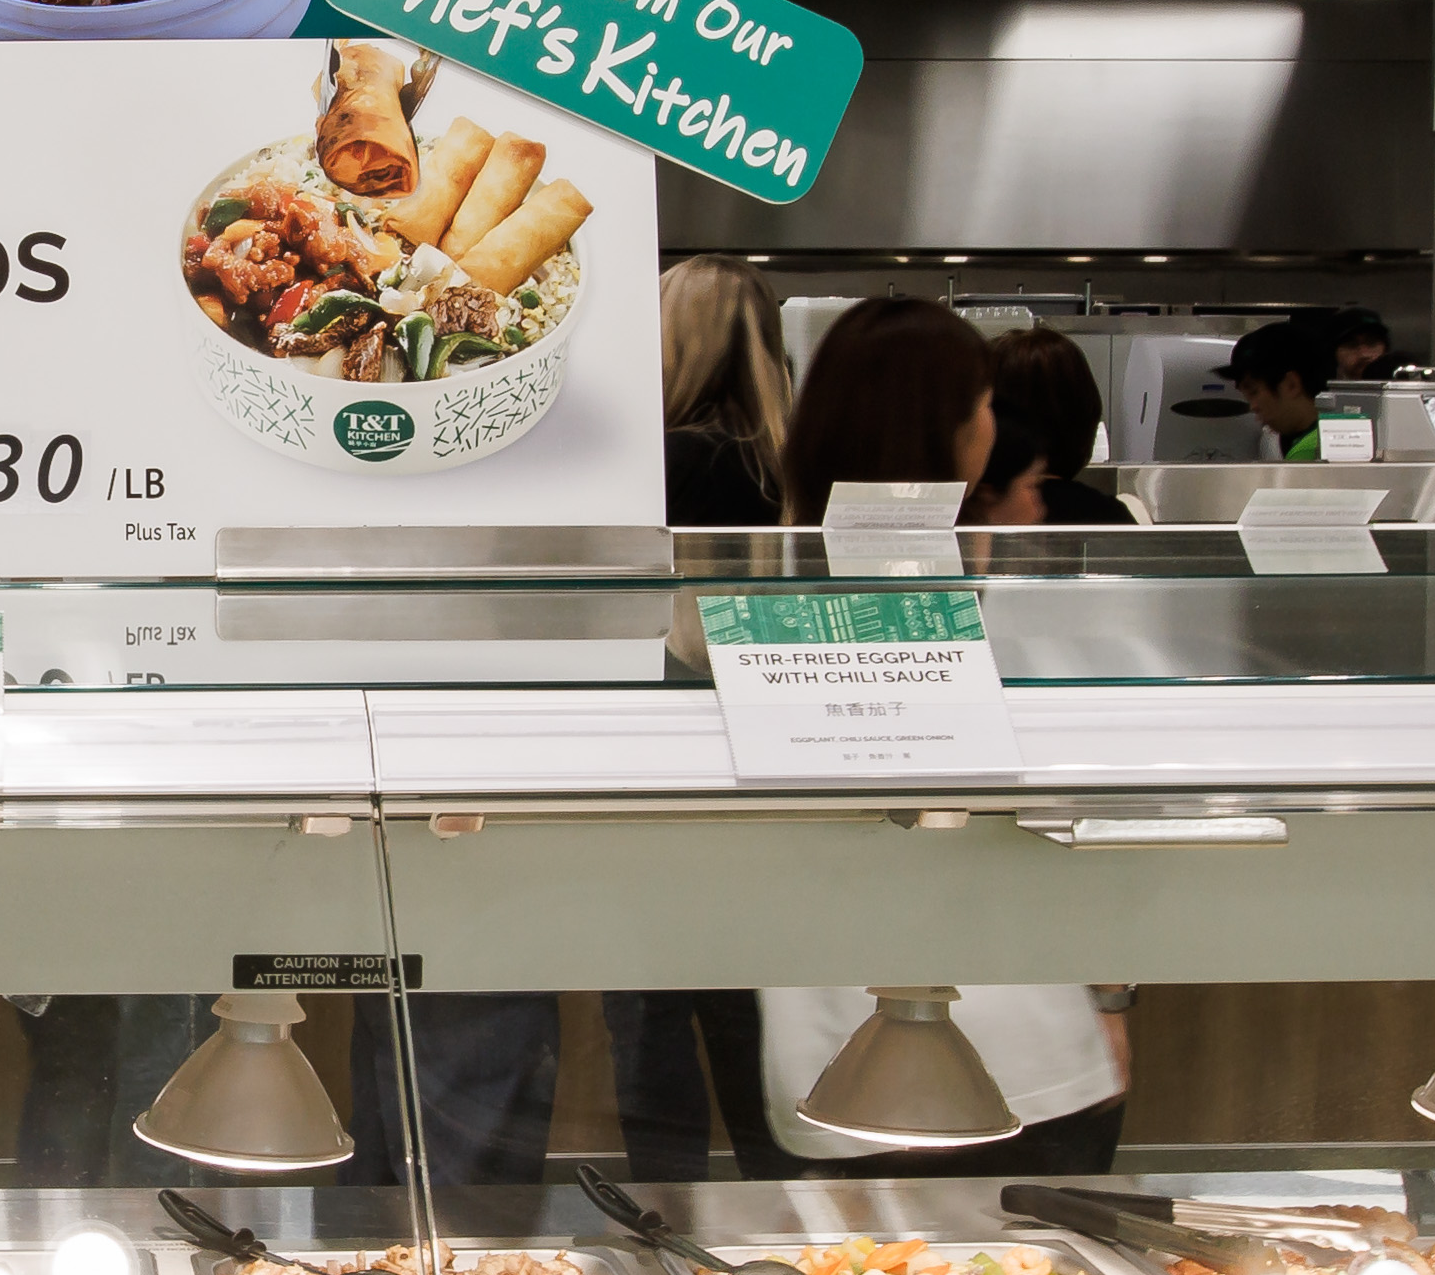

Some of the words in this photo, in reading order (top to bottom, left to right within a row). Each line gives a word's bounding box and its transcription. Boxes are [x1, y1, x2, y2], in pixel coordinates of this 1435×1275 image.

[584, 21, 811, 189] Kitchen
[342, 412, 405, 432] T&T
[347, 430, 401, 442] KITCHEN
[125, 522, 162, 541] Plus
[167, 522, 196, 541] Tax
[738, 652, 851, 666] STIR-FRIED
[856, 650, 964, 665] EGGPLANT
[762, 672, 820, 685] WITH
[824, 671, 878, 684] CHILI
[882, 670, 952, 683] SAUCE
[273, 956, 340, 969] CAUTION
[353, 956, 385, 969] HOT
[253, 973, 337, 985] ATTENTION
